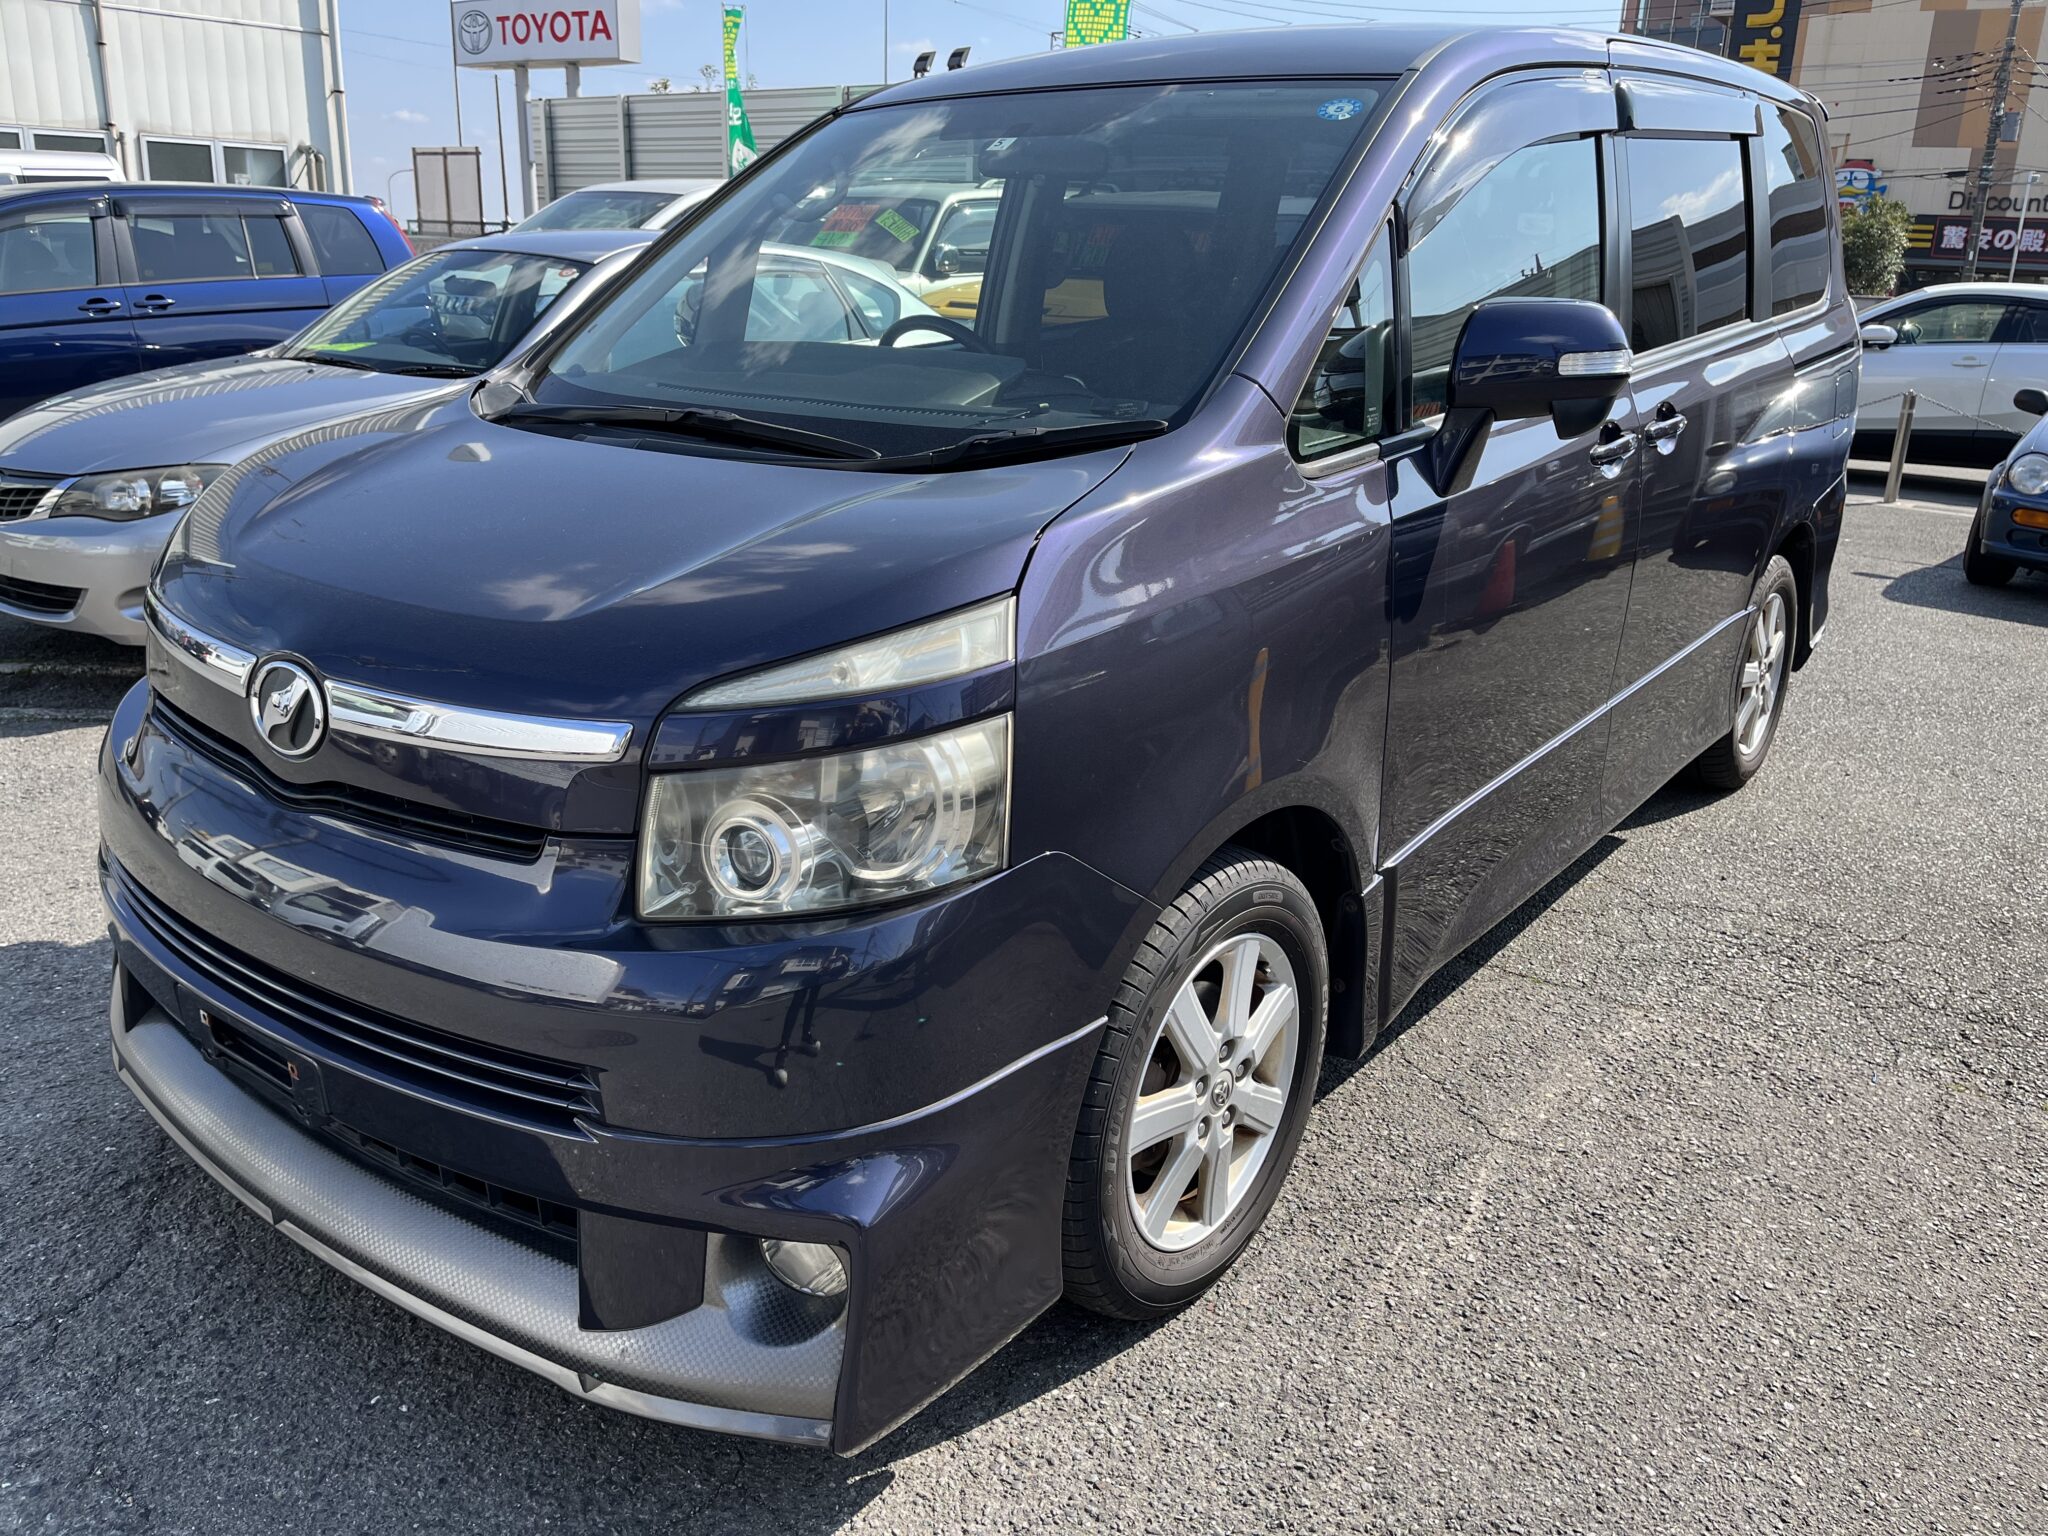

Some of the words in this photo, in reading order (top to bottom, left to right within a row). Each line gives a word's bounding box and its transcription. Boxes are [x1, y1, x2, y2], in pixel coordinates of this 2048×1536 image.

[496, 10, 612, 45] TOYOTA
[1948, 191, 2048, 213] Dicount
[1941, 225, 2048, 252] 驚安の殿
[1104, 1006, 1153, 1174] DUNLOP
